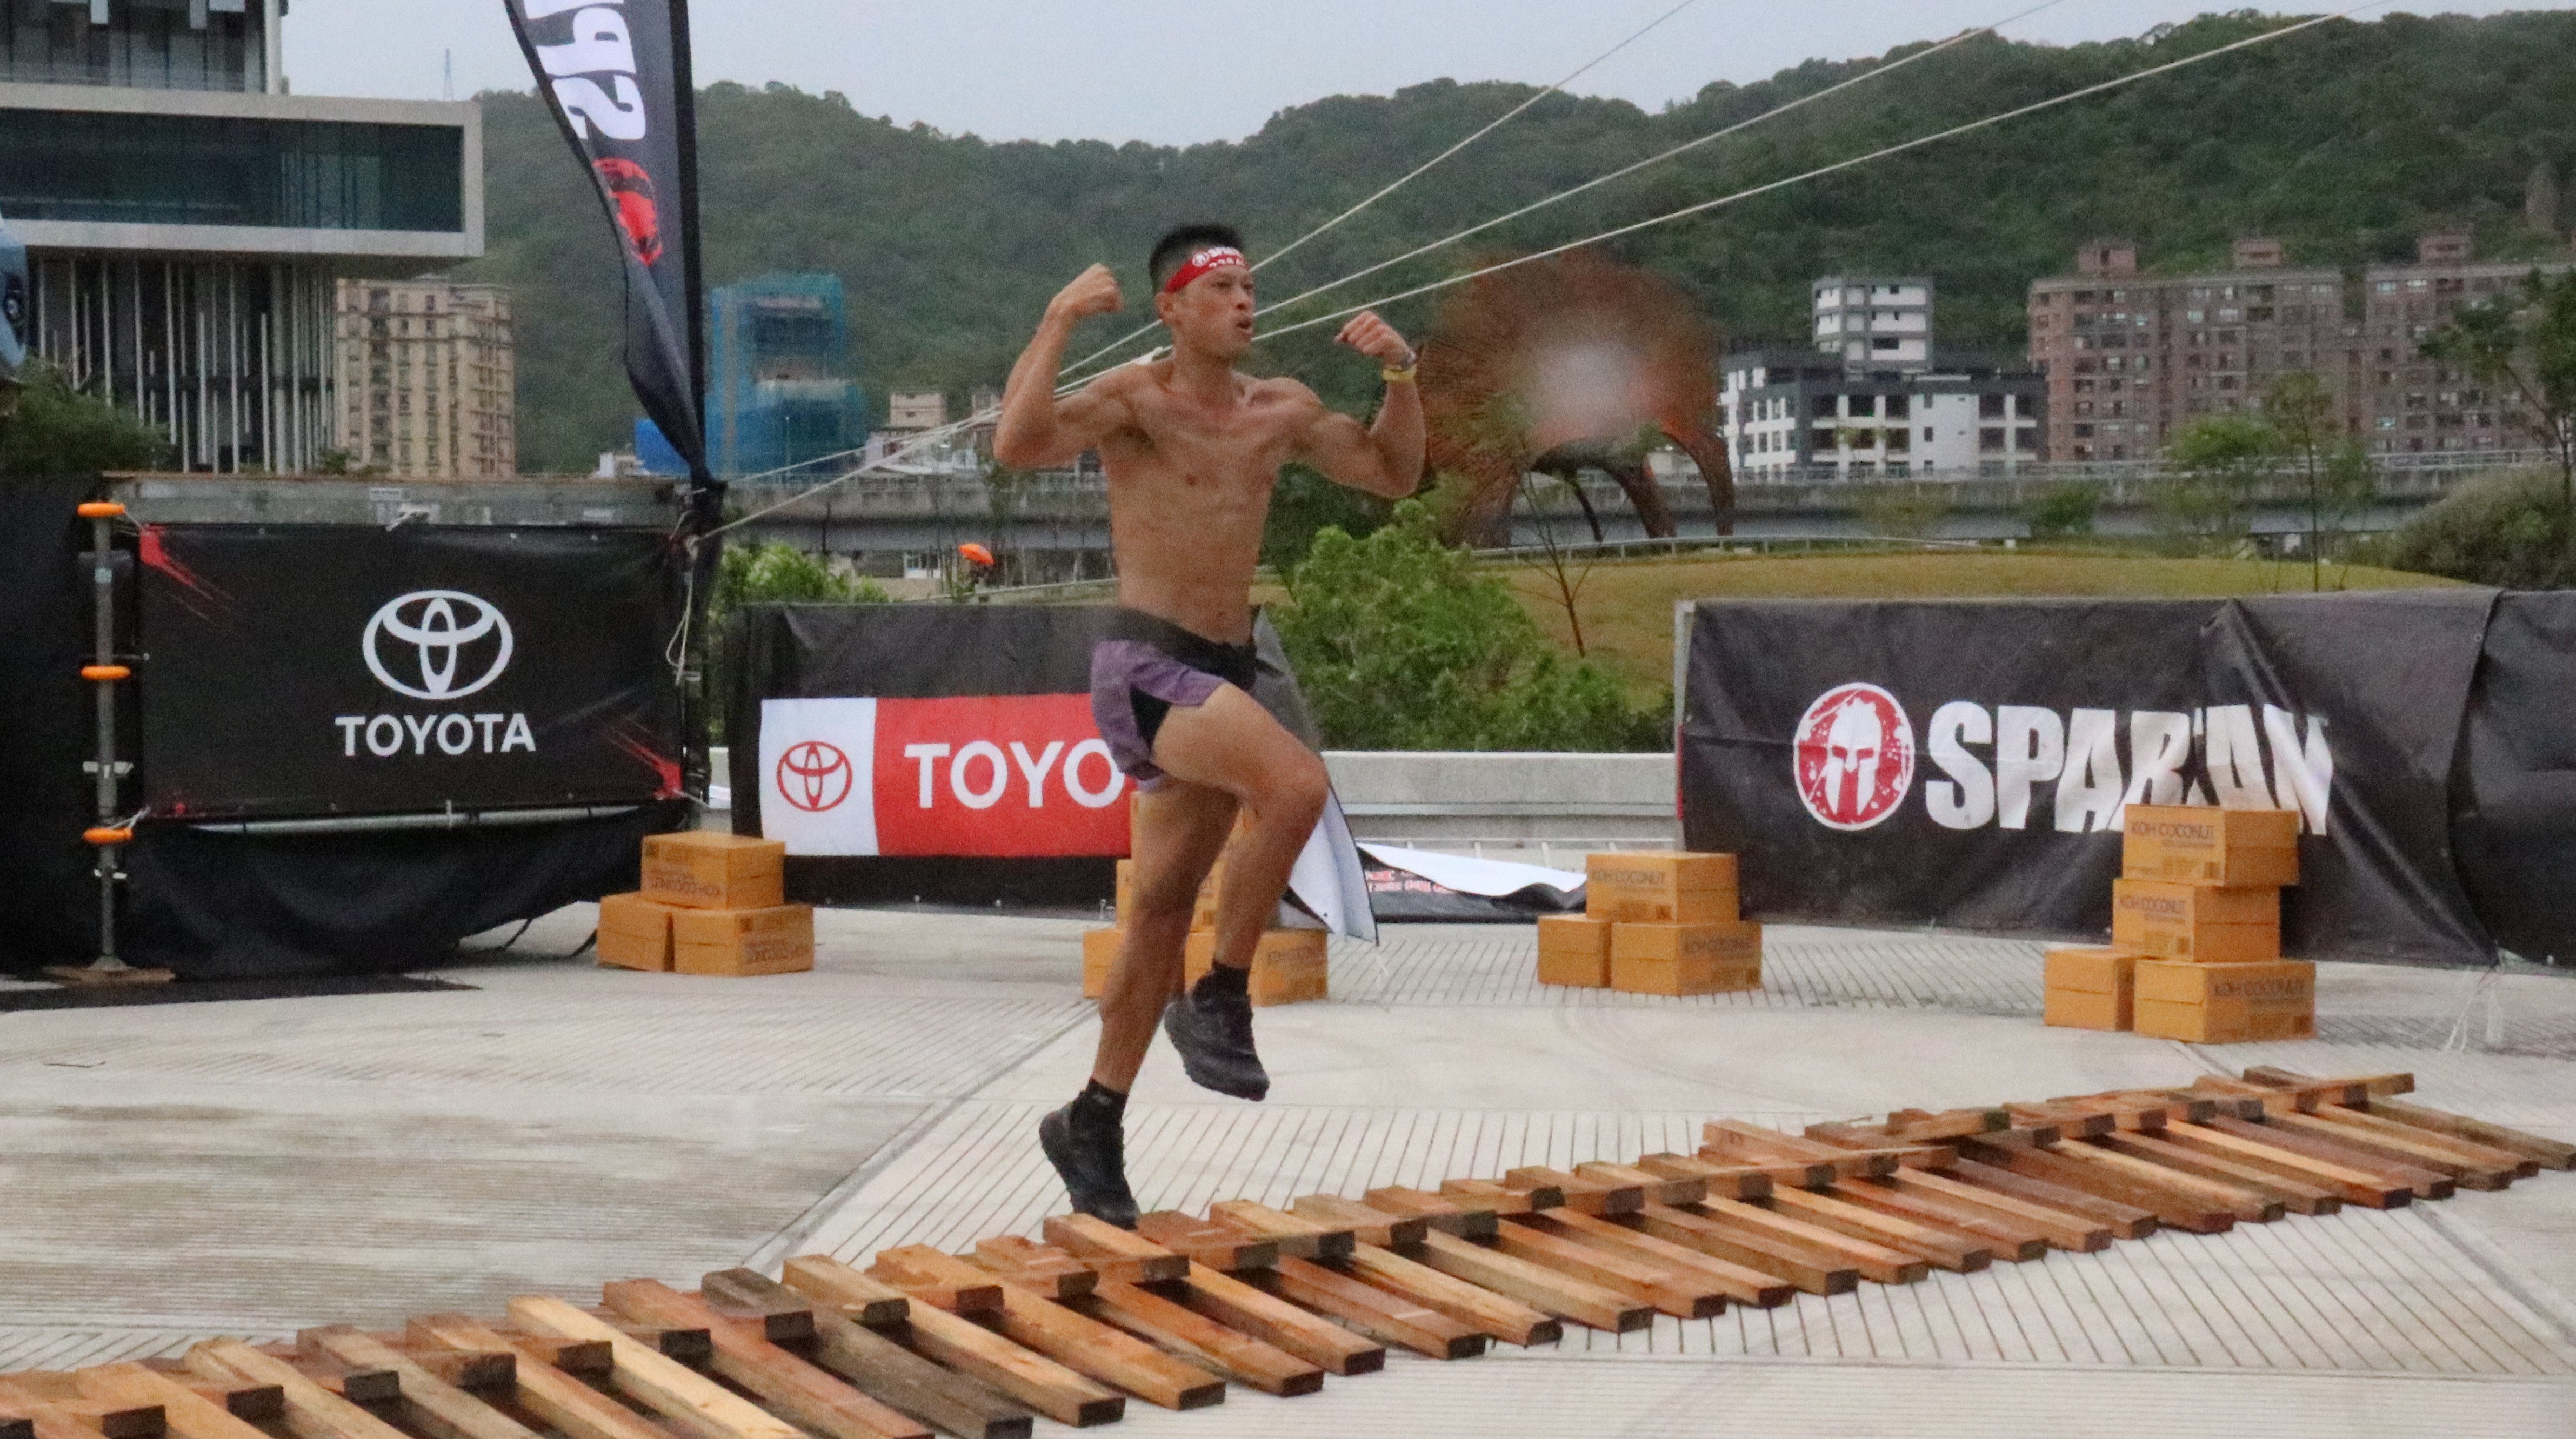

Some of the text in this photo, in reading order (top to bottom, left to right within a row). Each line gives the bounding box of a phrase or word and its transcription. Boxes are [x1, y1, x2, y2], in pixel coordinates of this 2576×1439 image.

[335, 713, 536, 757] TOYOTA
[2131, 821, 2215, 840] KOH COCONUT
